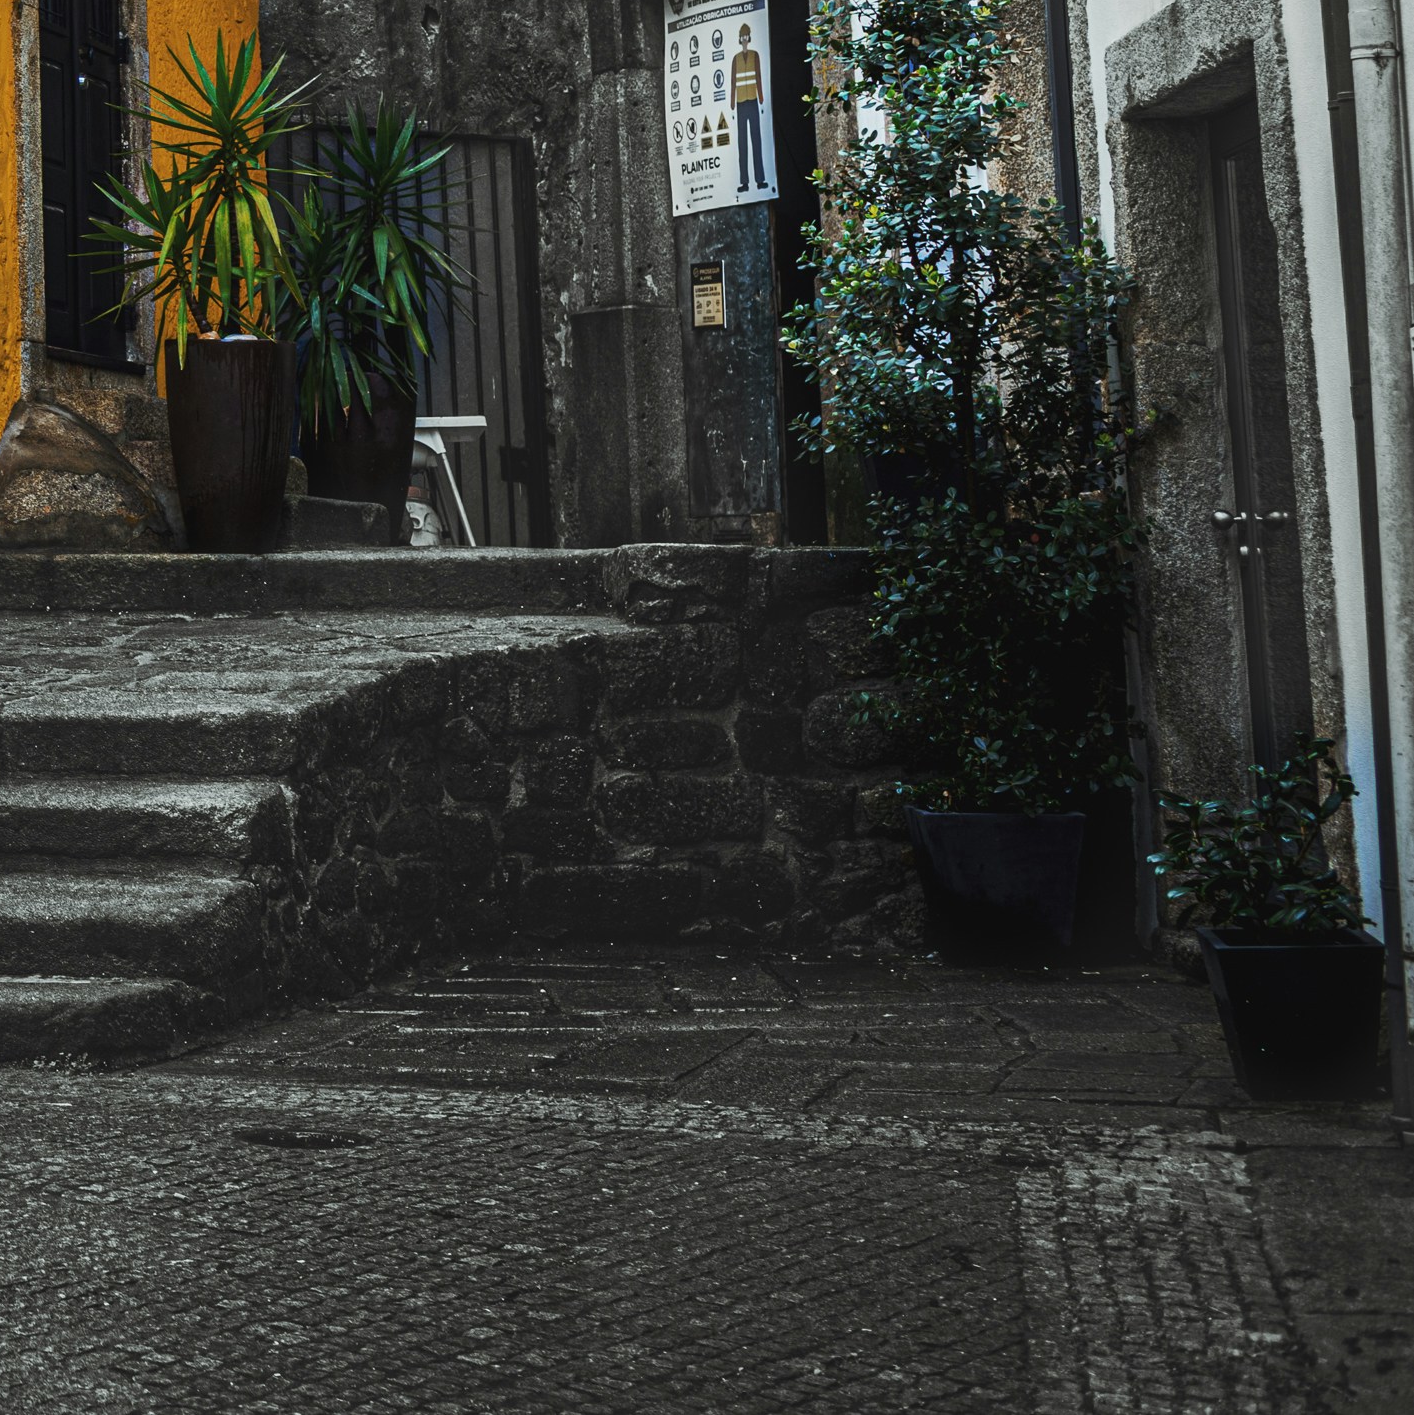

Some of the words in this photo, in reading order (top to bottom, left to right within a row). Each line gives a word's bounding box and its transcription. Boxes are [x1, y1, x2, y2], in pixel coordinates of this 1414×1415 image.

[703, 5, 743, 21] OBRIGATÓRIA
[744, 3, 754, 11] DE:
[681, 156, 721, 175] PLAINTEC
